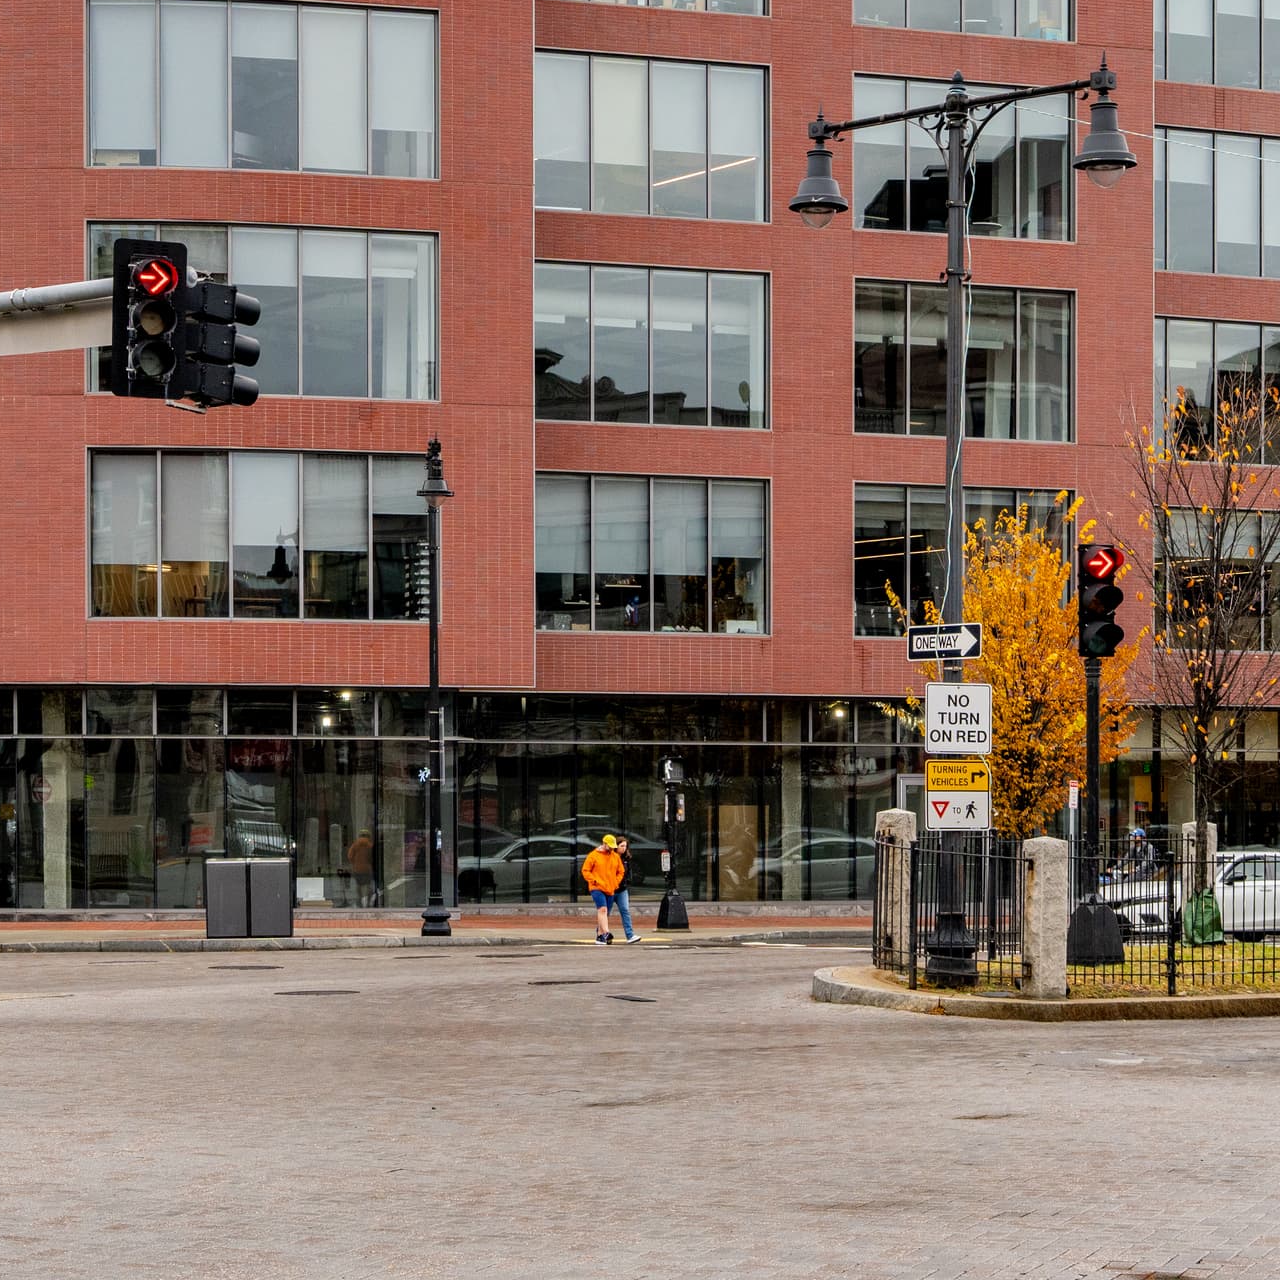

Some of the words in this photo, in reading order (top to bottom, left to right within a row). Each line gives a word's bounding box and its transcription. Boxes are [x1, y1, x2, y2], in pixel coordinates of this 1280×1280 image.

[915, 636, 936, 650] ONE
[938, 635, 959, 649] WAY
[947, 694, 970, 708] NO
[938, 711, 980, 725] TURN
[929, 729, 952, 743] ON
[956, 730, 987, 743] RED
[932, 765, 968, 774] TURNING
[931, 778, 969, 787] VEHICLES
[952, 807, 962, 815] TO
